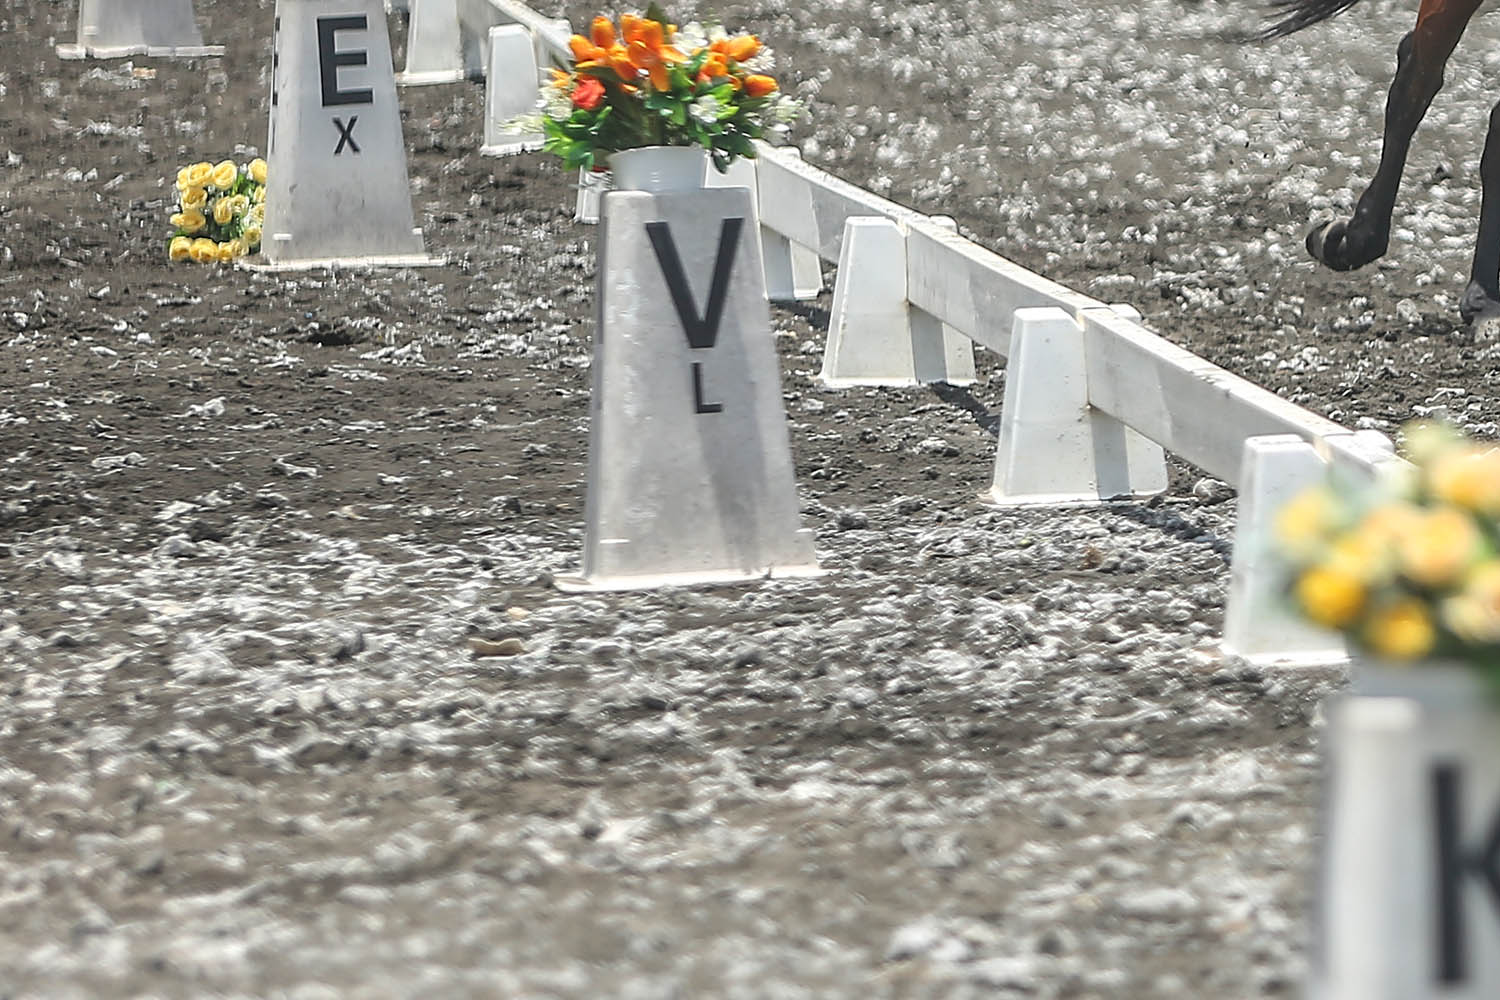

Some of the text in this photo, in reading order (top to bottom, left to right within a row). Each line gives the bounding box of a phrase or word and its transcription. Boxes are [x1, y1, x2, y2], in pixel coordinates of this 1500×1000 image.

[317, 15, 374, 107] E
[332, 115, 360, 155] X
[645, 217, 744, 348] V
[691, 362, 723, 414] L
